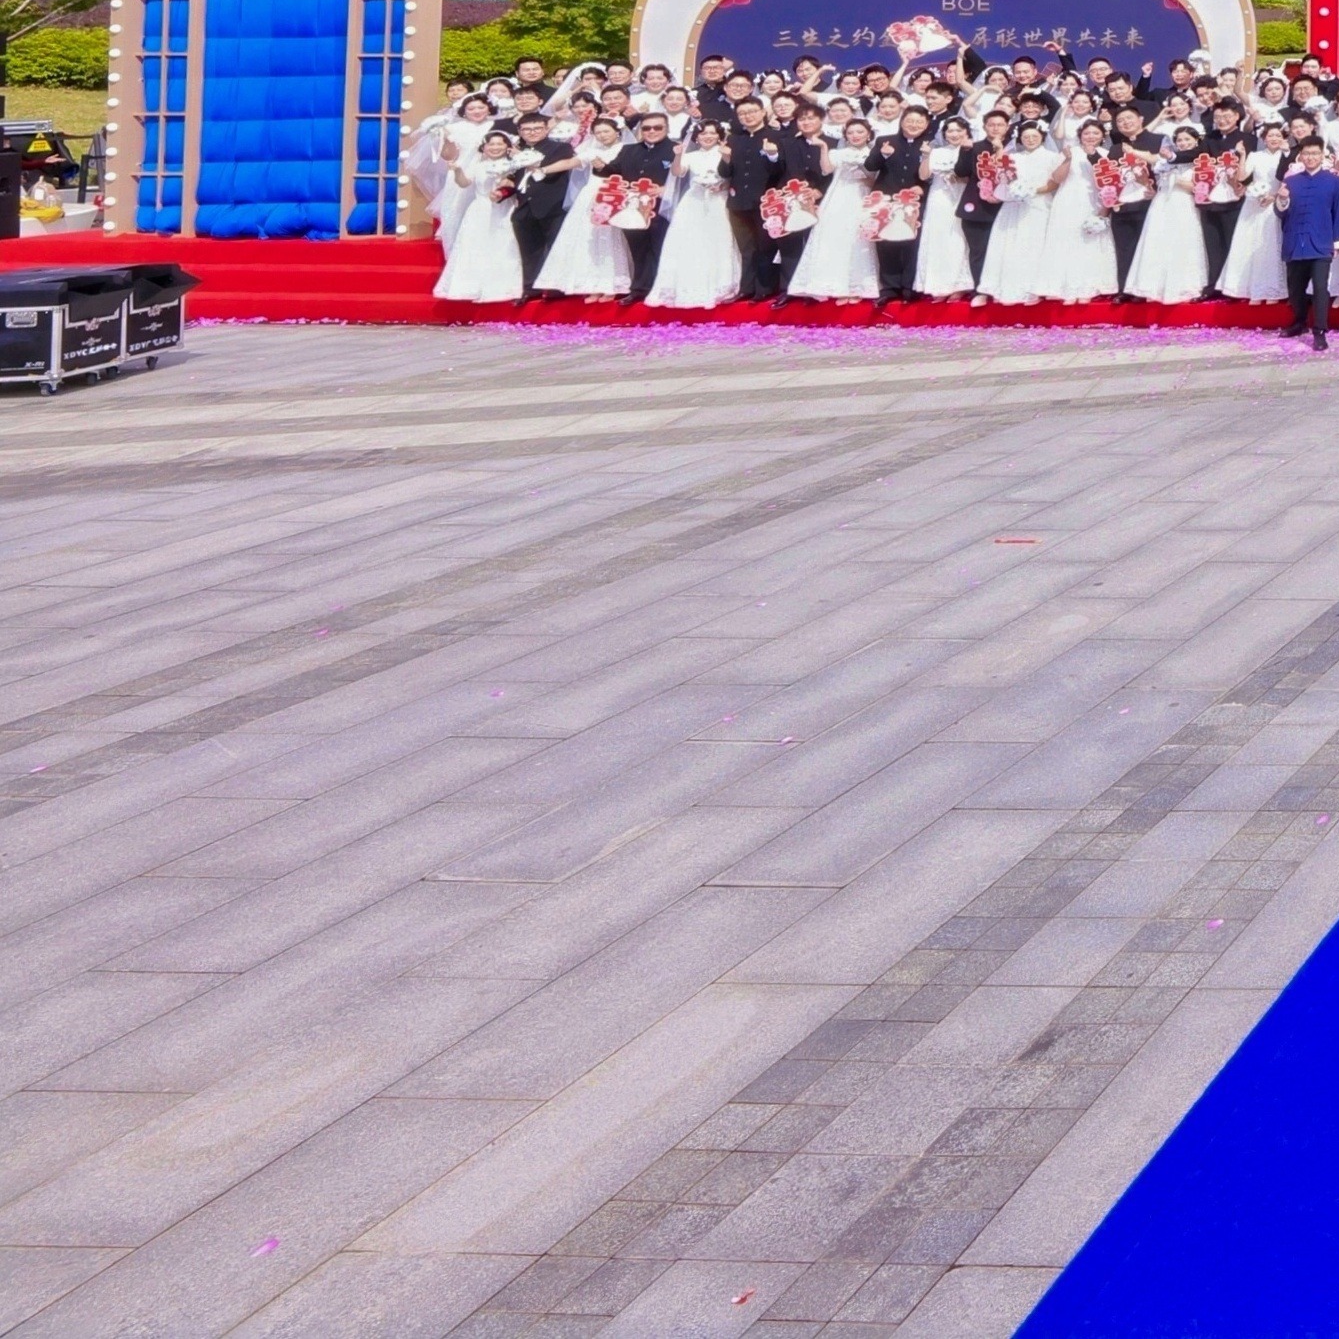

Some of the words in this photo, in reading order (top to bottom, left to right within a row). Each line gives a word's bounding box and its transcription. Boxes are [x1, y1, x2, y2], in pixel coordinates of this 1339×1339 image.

[971, 26, 1145, 49] 屏联世界共未来
